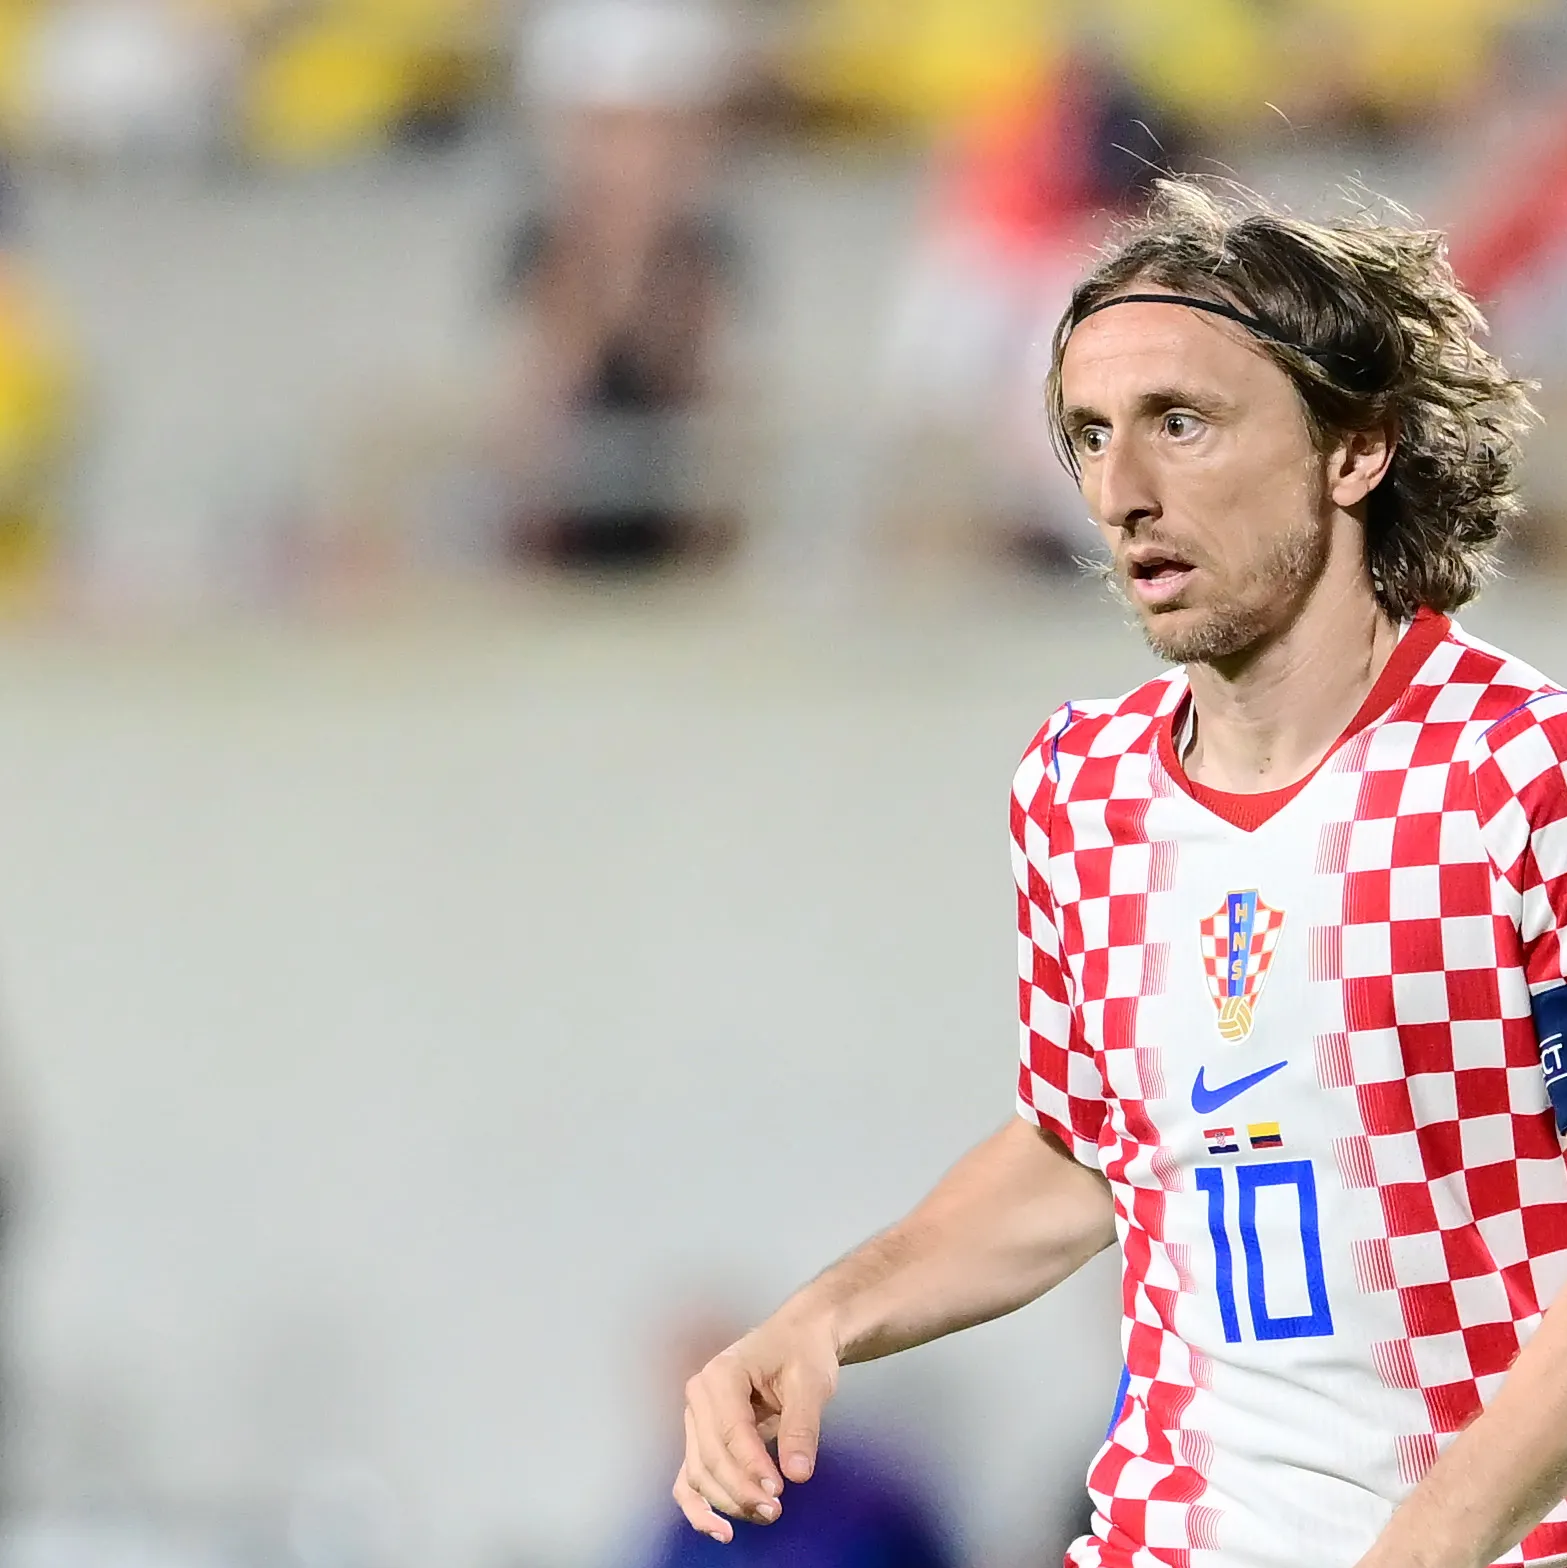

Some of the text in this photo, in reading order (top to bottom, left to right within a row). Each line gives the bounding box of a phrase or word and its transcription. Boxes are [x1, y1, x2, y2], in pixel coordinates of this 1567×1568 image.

[1232, 902, 1248, 980] HNS
[1541, 1043, 1563, 1075] CT
[1195, 1160, 1334, 1343] 10
